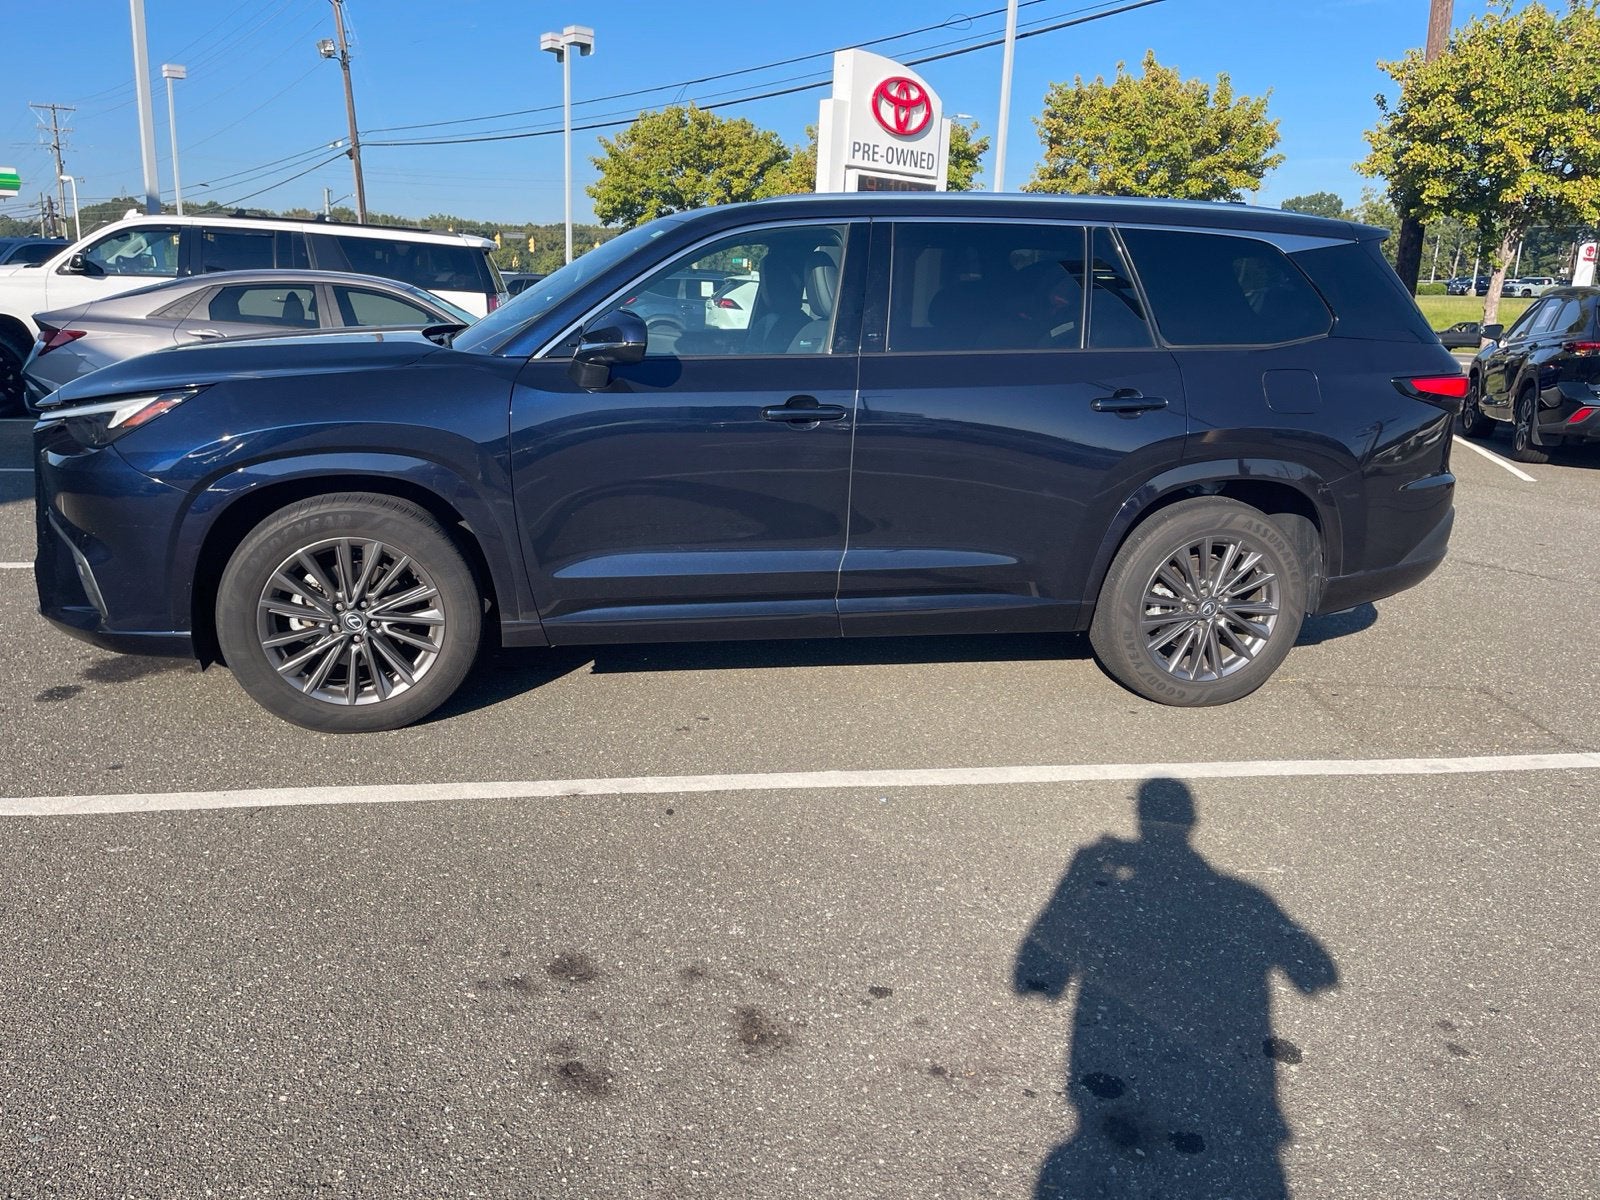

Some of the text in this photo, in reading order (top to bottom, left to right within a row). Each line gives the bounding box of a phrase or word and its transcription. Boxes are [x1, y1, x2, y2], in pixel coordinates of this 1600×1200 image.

[851, 141, 935, 171] PRE-OWNED
[1242, 520, 1301, 589] ASSURANCE
[1123, 630, 1187, 700] GOODYEAR
